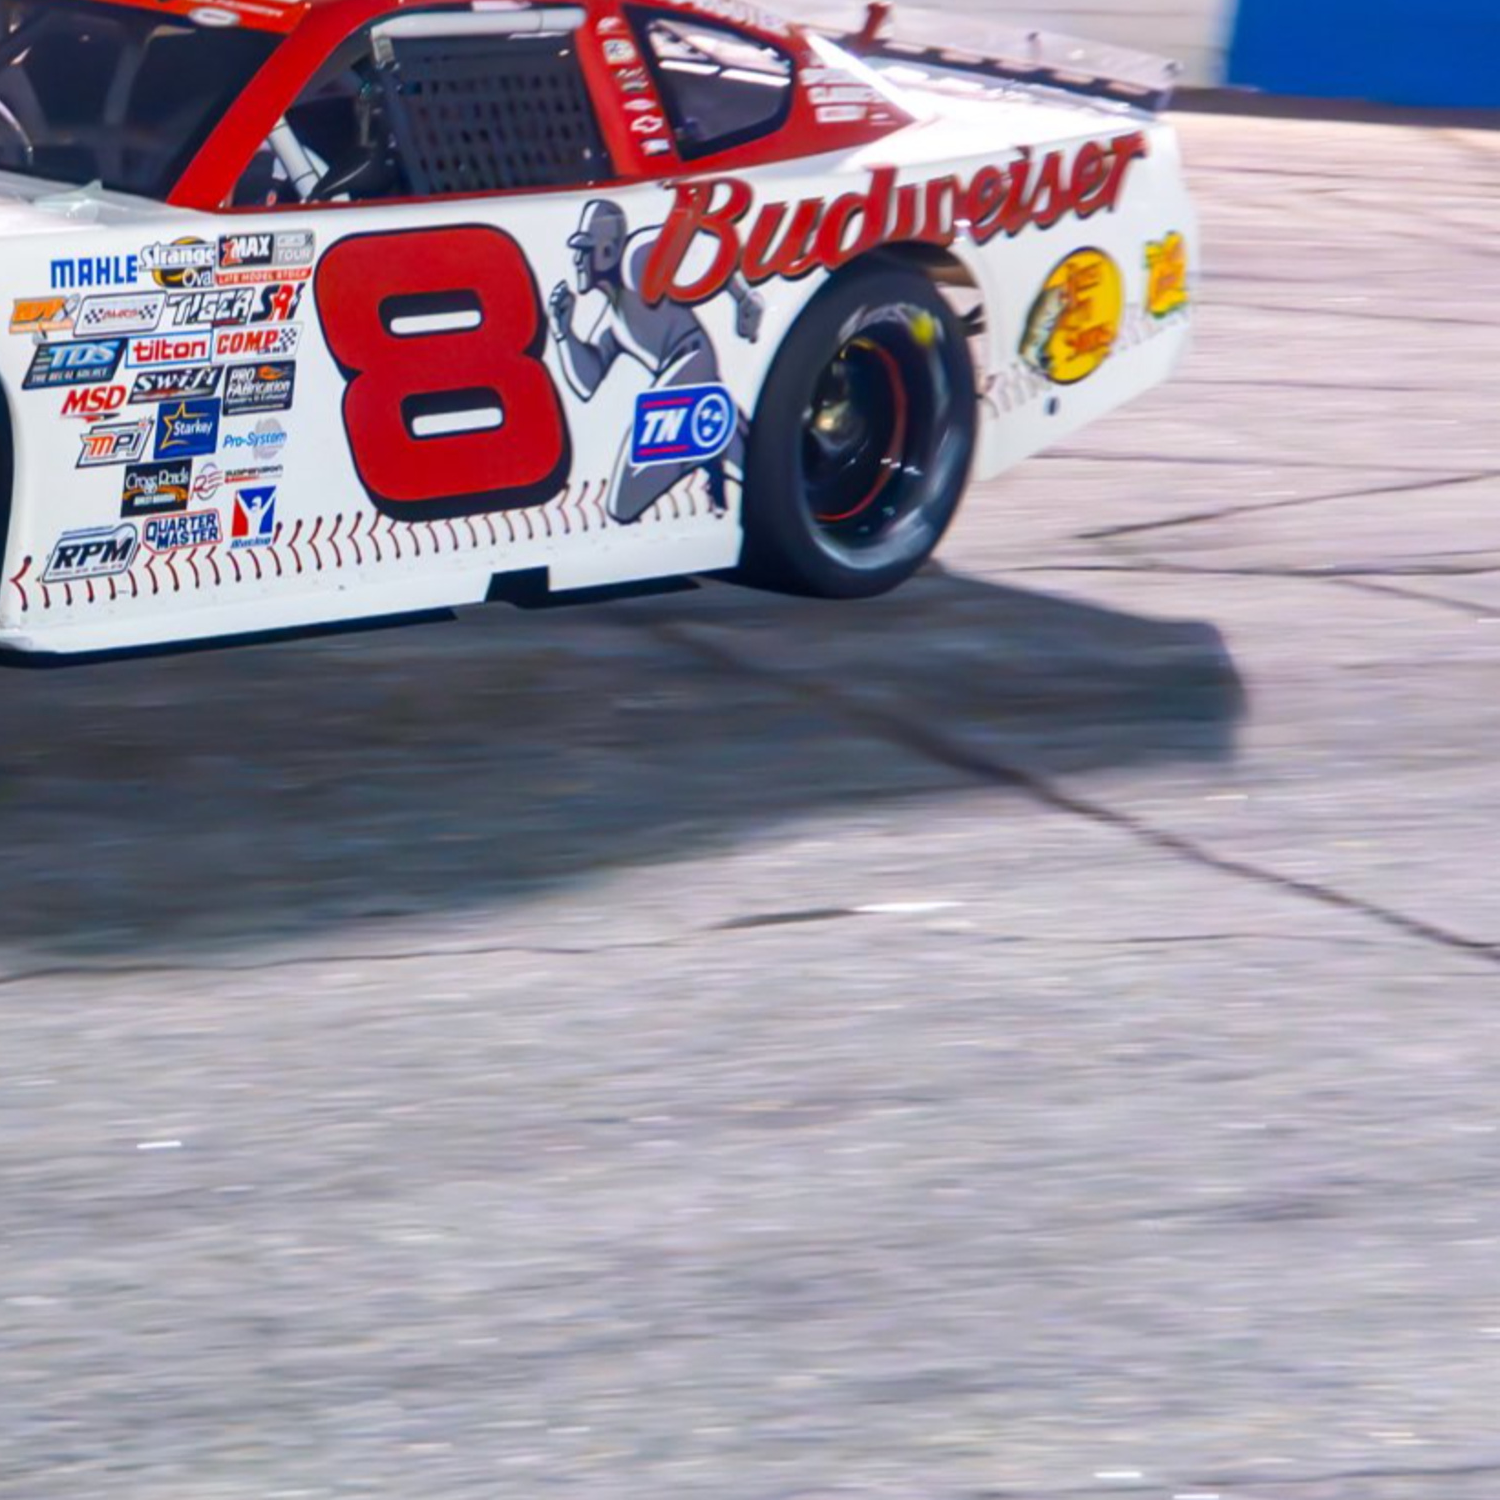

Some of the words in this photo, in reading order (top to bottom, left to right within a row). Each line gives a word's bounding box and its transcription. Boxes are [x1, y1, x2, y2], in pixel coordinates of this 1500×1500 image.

[640, 130, 1149, 309] Budweiser
[50, 254, 138, 289] MAHLE
[168, 289, 252, 325] TIGER
[49, 338, 121, 368] TDS
[133, 338, 207, 363] tilton
[216, 329, 279, 355] COMP
[312, 221, 573, 523] 8
[61, 384, 127, 415] MSD
[173, 417, 214, 438] Starkey
[222, 431, 288, 449] Pro-System
[638, 408, 687, 446] TN
[145, 513, 217, 542] QUARTER
[156, 525, 219, 551] MASTER
[52, 536, 135, 570] RPM
